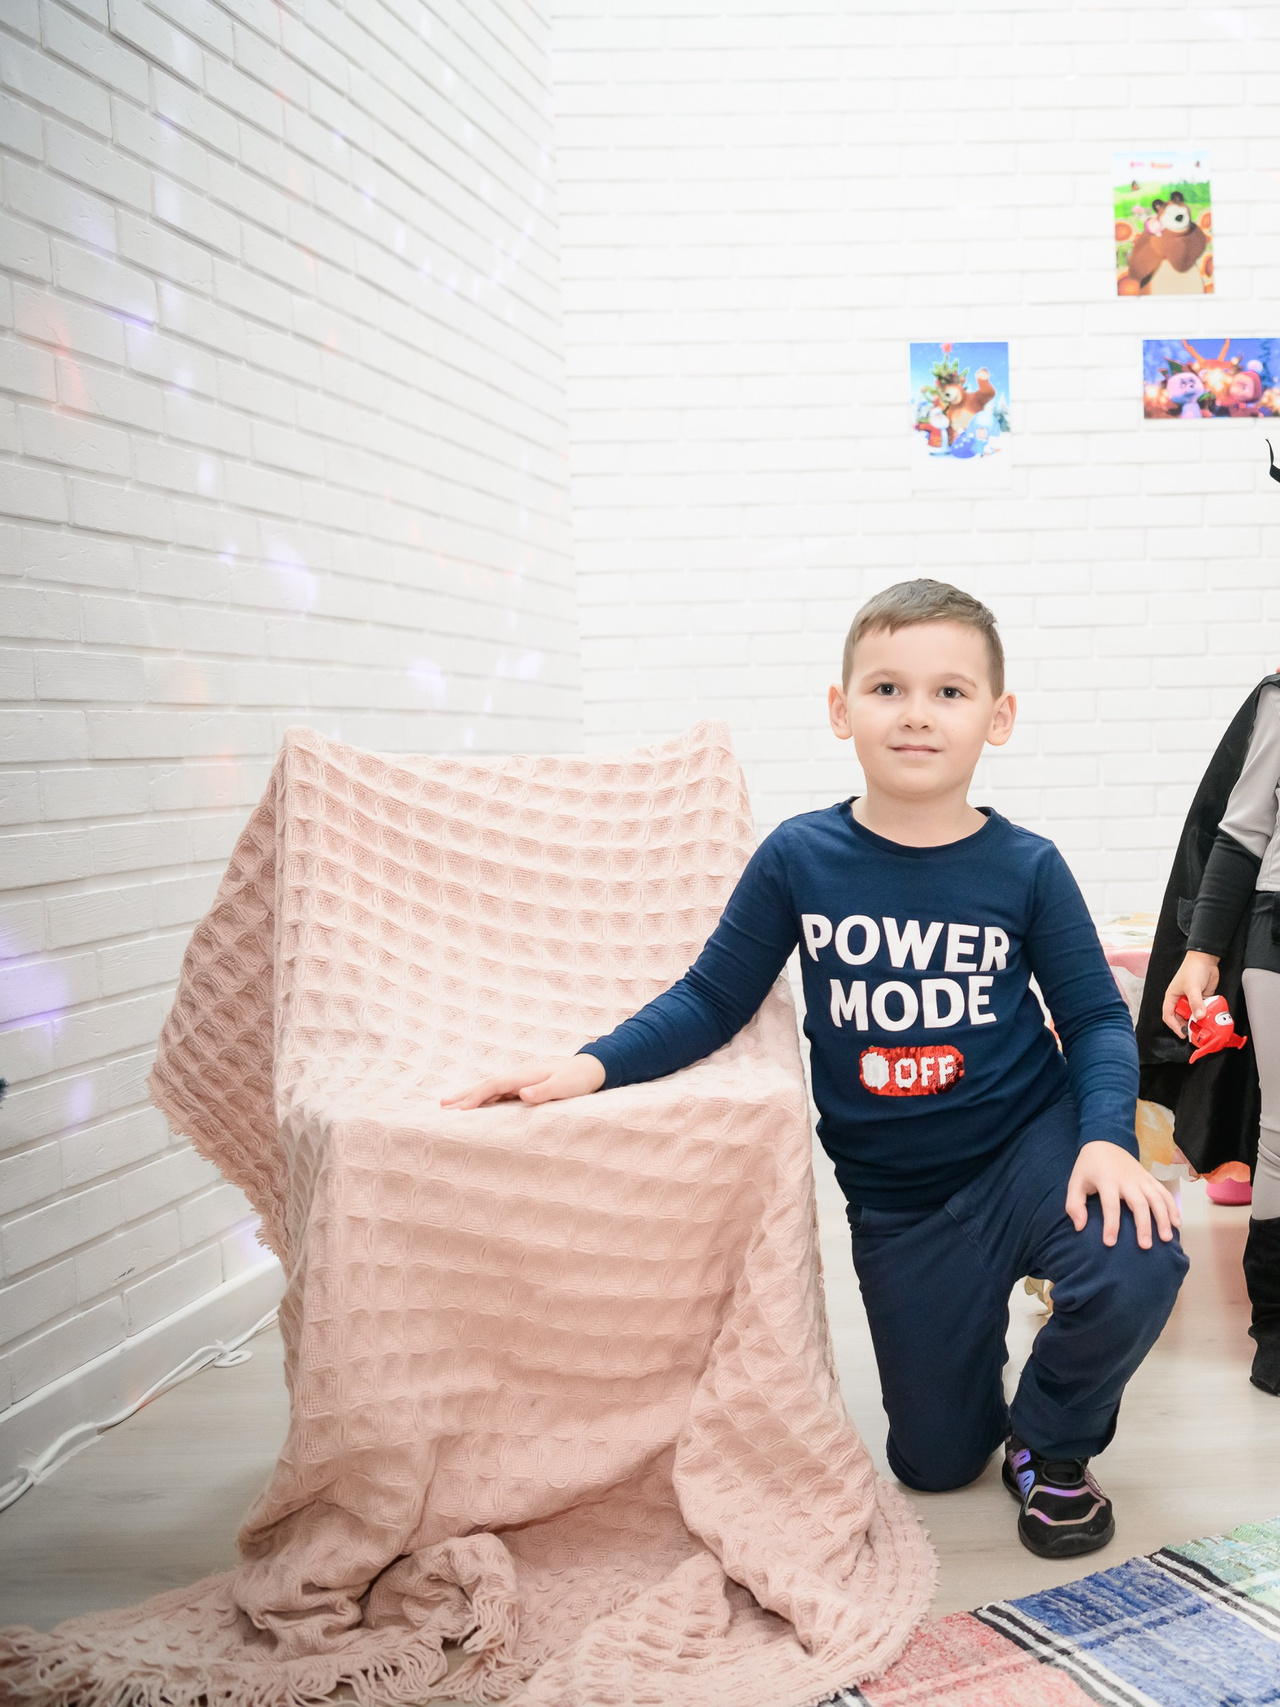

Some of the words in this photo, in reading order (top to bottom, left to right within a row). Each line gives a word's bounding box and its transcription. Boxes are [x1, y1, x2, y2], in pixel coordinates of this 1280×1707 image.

[801, 914, 1010, 972] POWER
[830, 976, 997, 1031] MODE
[895, 1055, 956, 1088] OFF
